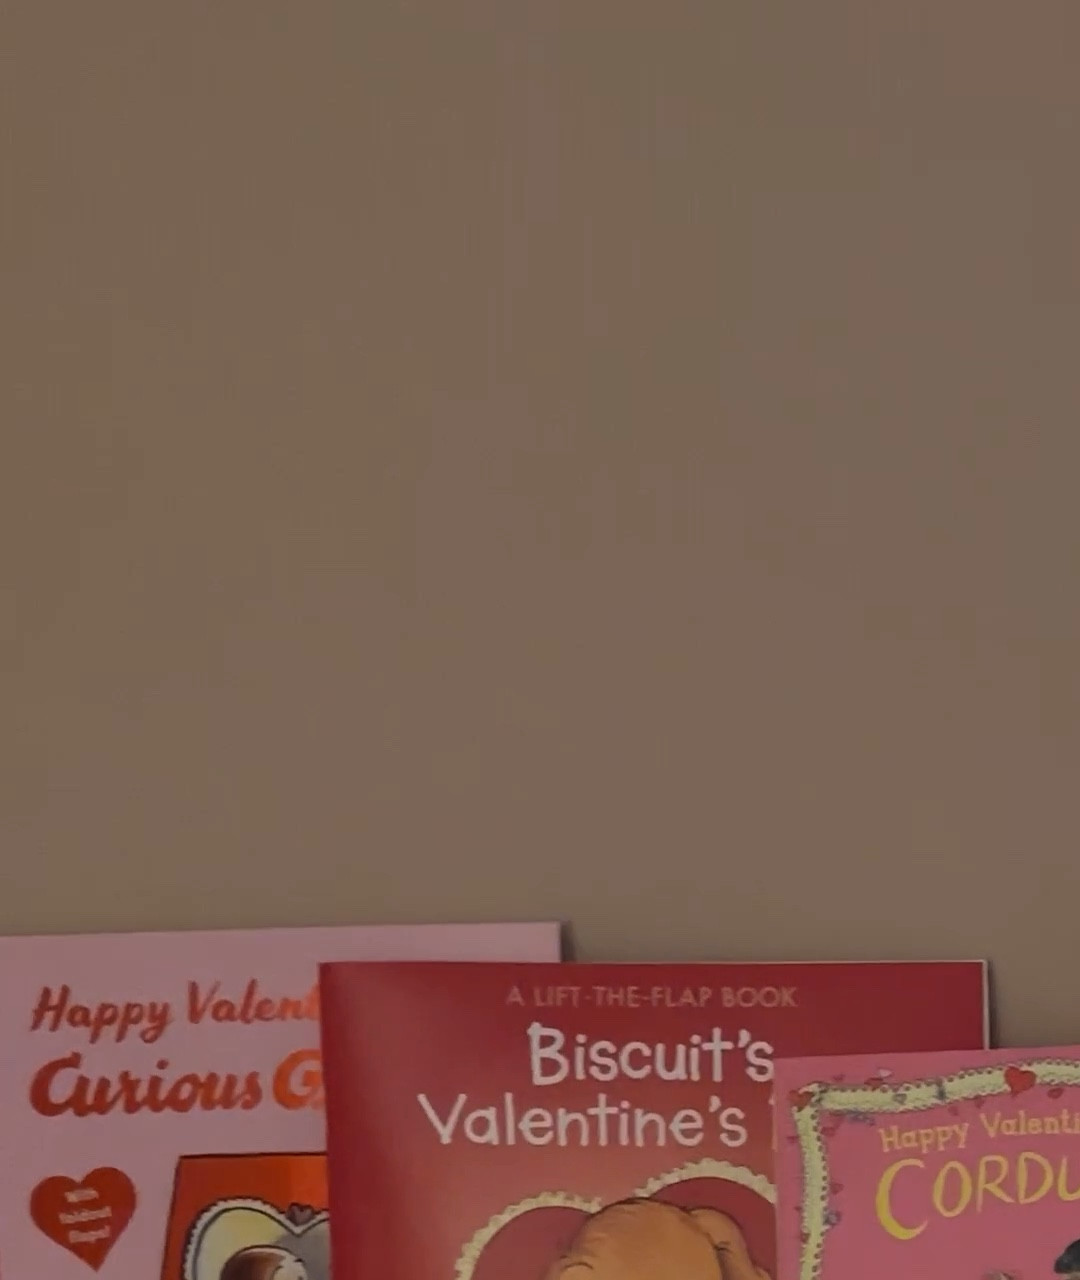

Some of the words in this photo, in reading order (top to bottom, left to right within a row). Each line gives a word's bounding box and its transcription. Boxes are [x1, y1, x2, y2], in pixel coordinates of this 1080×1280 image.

[29, 983, 172, 1044] Happy
[505, 985, 525, 1006] A
[720, 984, 799, 1008] BOOK
[527, 1021, 775, 1086] Biscuit's
[29, 1051, 263, 1117] Curious
[417, 1091, 749, 1147] Valentine's
[879, 1120, 969, 1153] Happy
